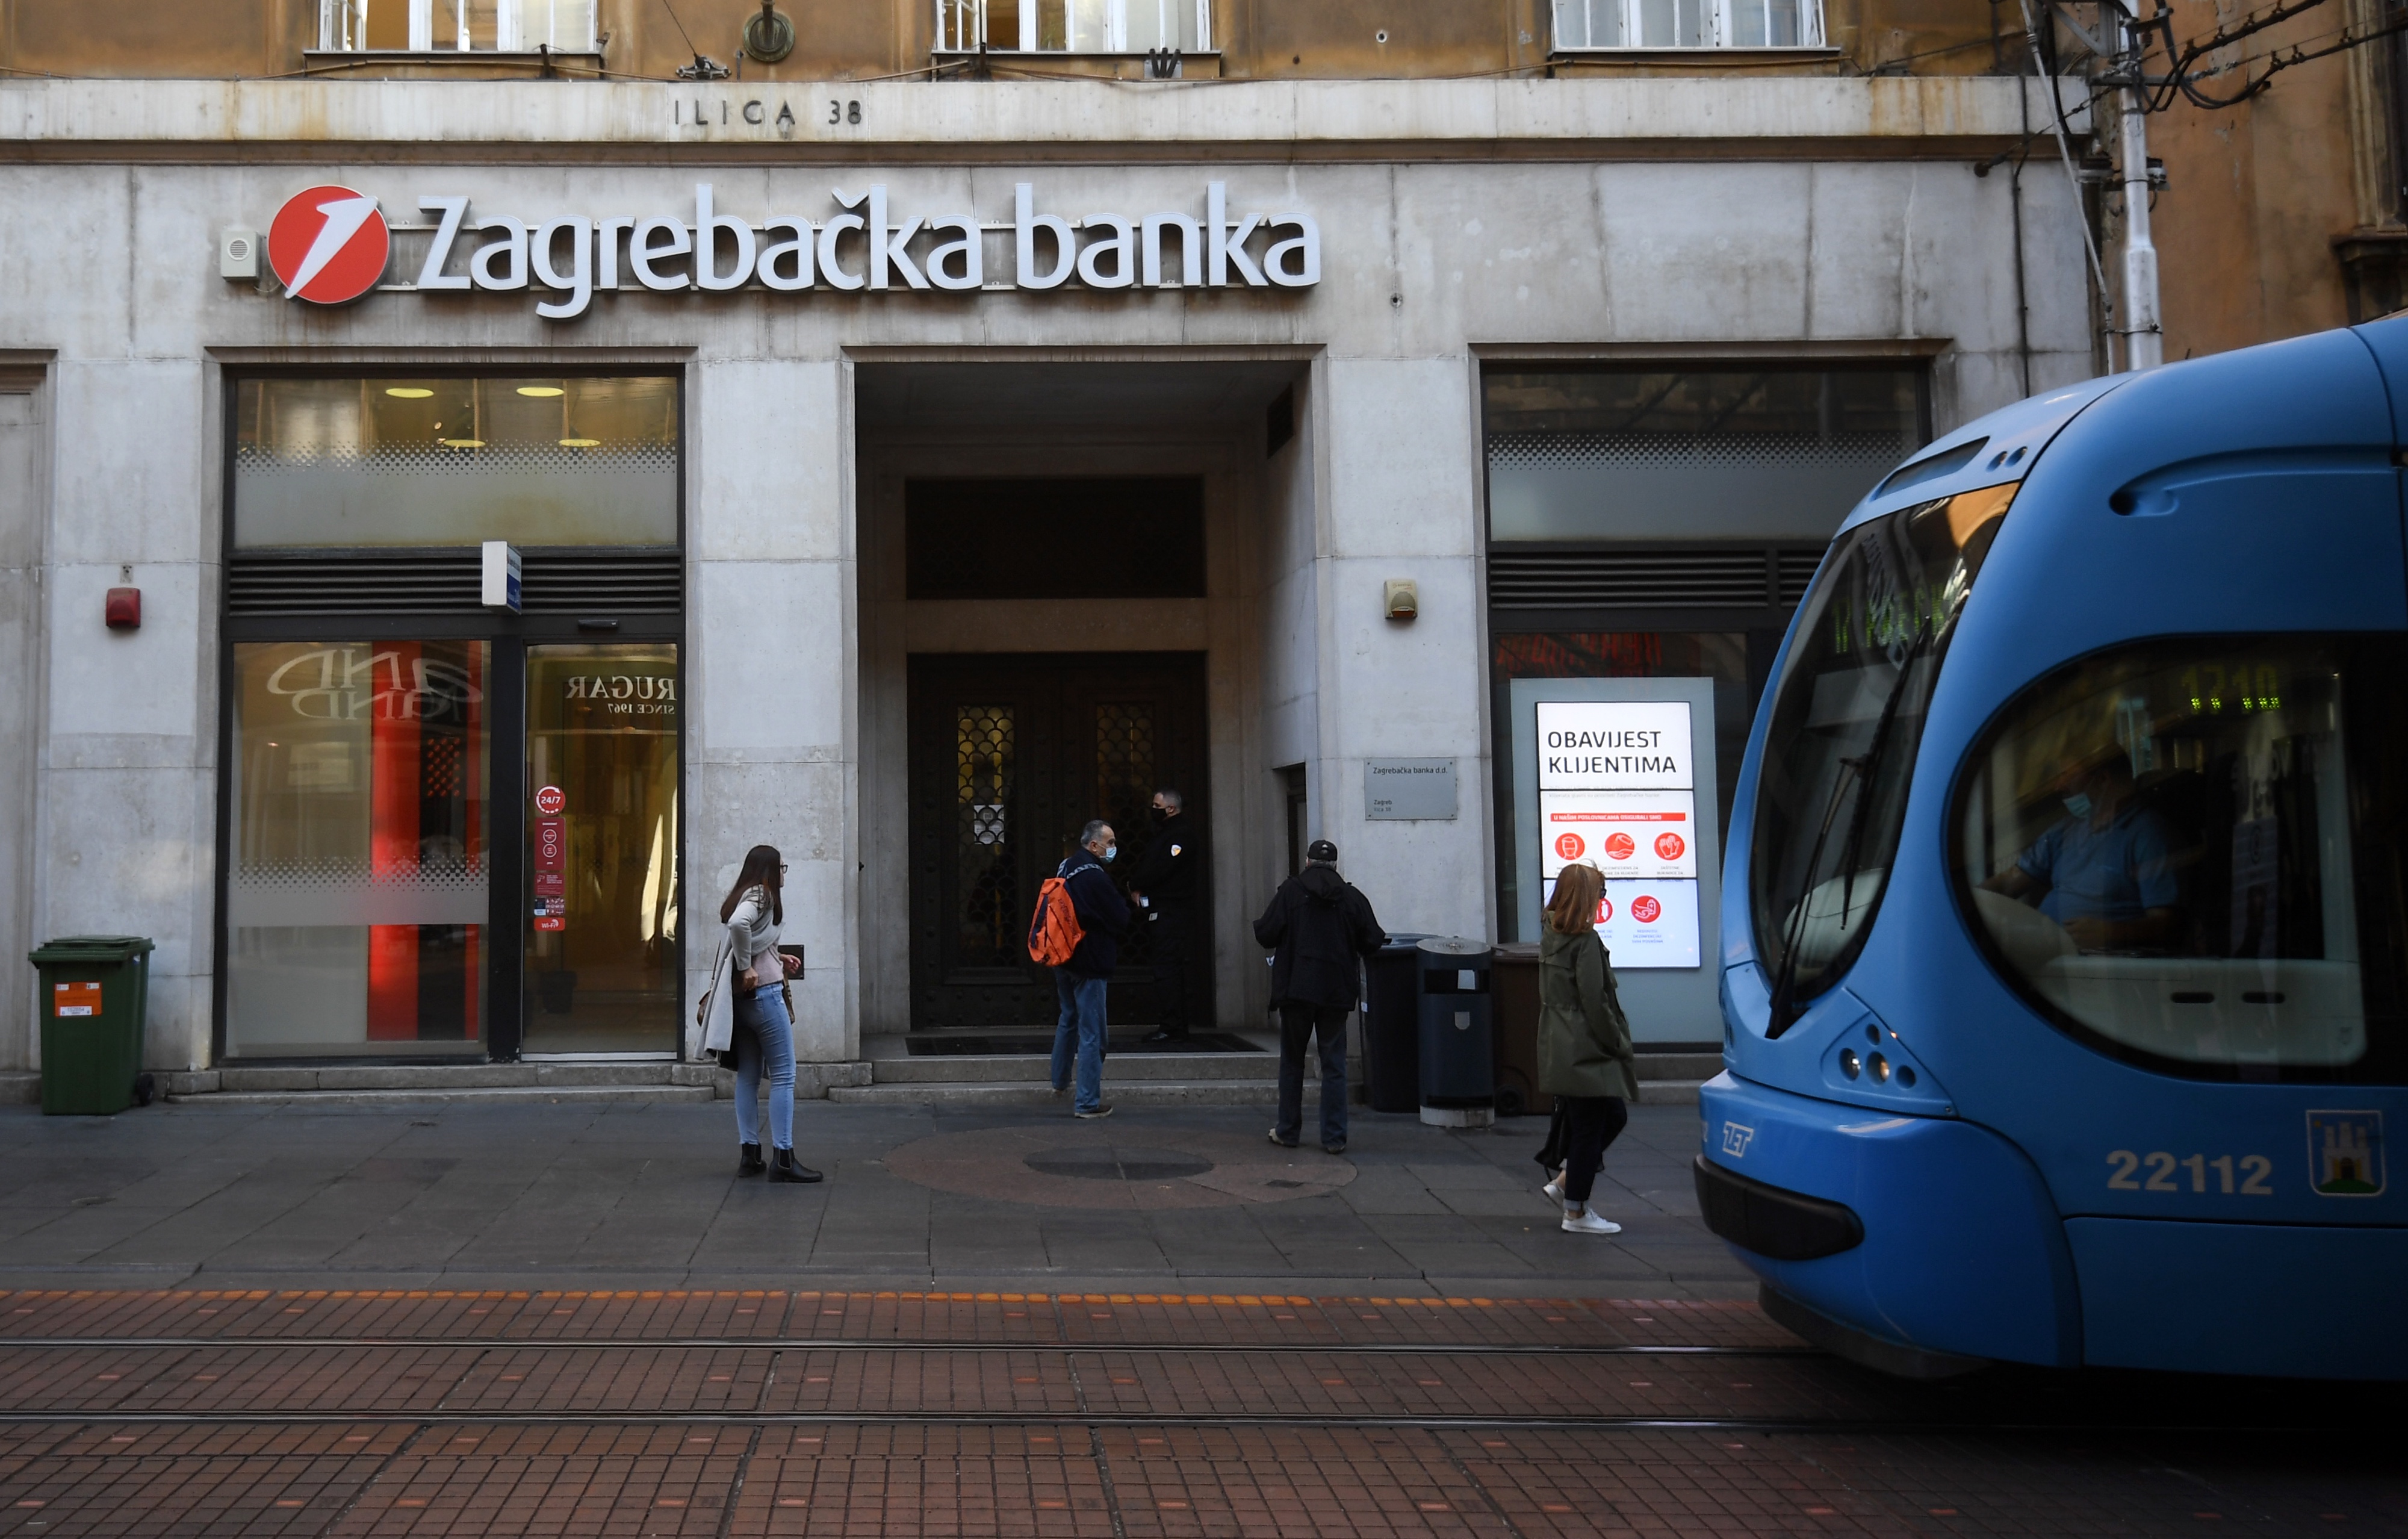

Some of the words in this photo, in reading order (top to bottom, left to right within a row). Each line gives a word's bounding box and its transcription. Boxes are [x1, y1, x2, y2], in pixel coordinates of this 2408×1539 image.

[675, 100, 795, 125] ILICA
[828, 100, 861, 124] 38
[417, 183, 982, 320] Zagrebačka
[1015, 181, 1321, 290] banka
[1548, 731, 1662, 748] OBAVIJEST
[1549, 756, 1677, 773] KLIJENTIMA
[541, 796, 561, 804] 24/7
[2106, 1149, 2273, 1195] 22112
